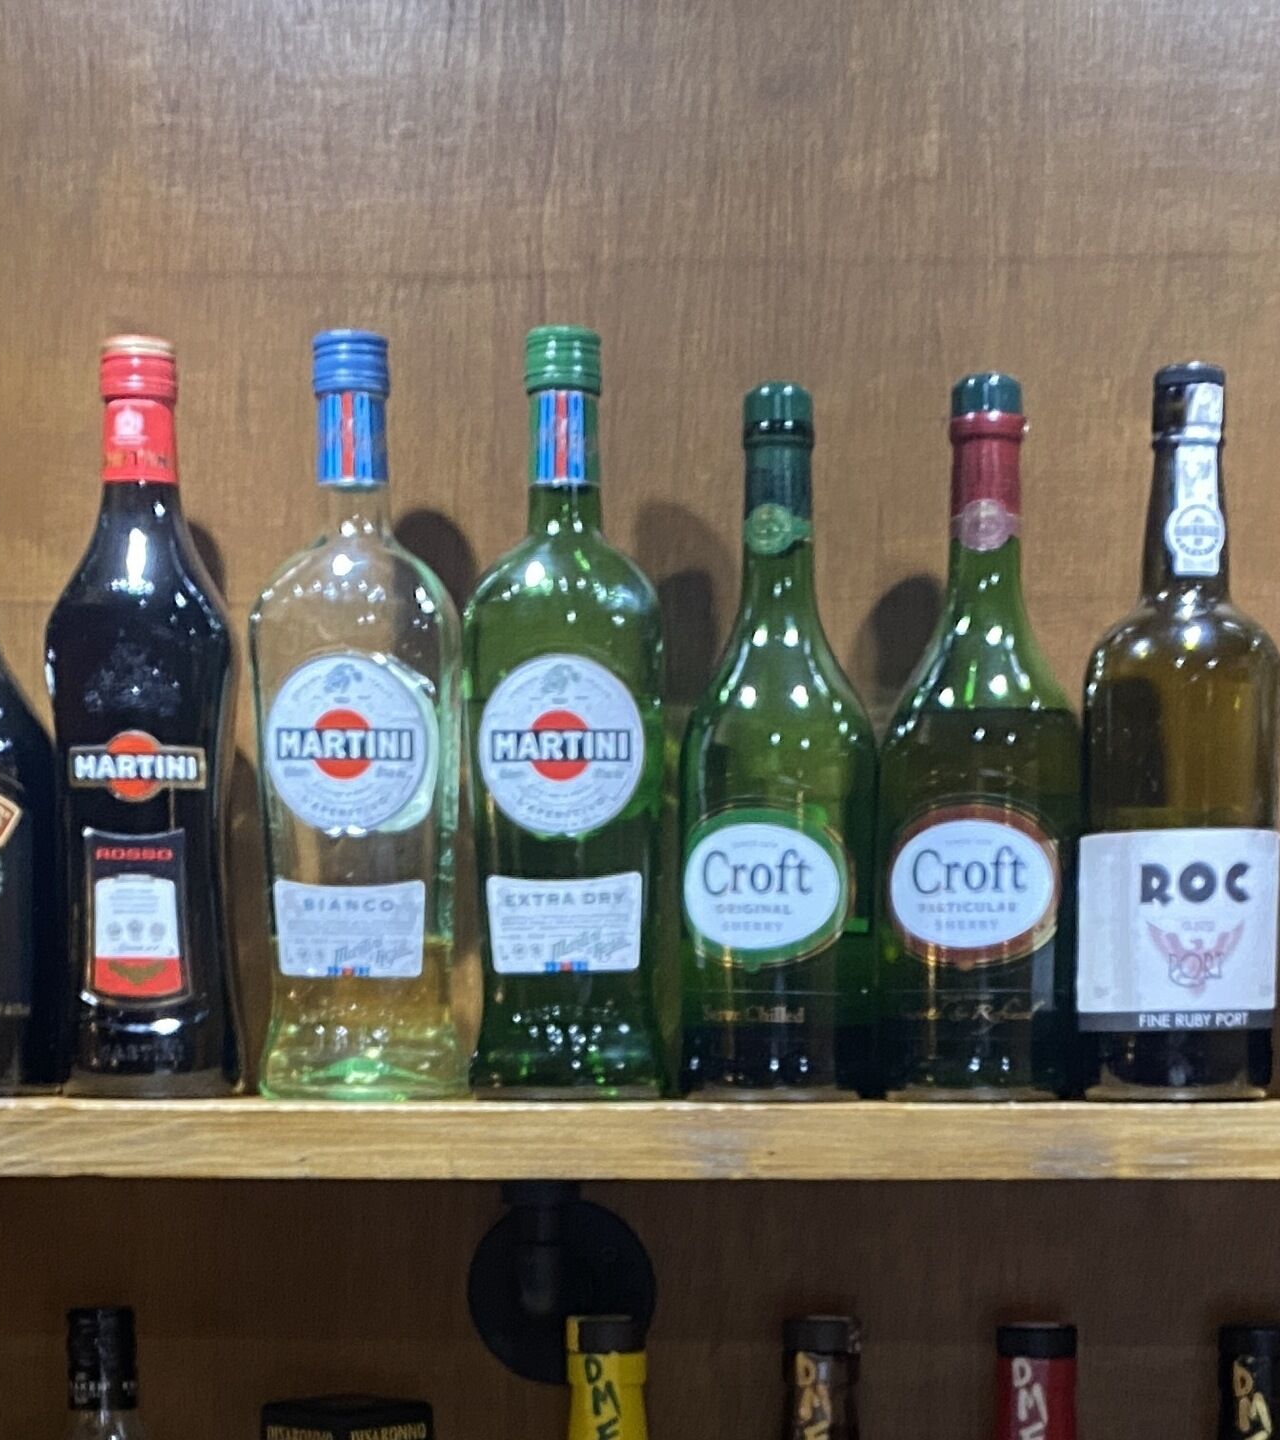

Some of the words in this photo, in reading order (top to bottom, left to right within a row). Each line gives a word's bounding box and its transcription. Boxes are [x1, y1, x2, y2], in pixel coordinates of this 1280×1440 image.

[278, 729, 414, 760] MARTINI
[493, 730, 629, 761] MARTINI
[74, 754, 198, 780] MARTINI
[702, 848, 813, 896] Croft
[912, 845, 1028, 896] Croft
[1139, 861, 1252, 907] ROC
[303, 897, 396, 913] BIANCO
[504, 892, 576, 909] EXTRA
[580, 892, 626, 906] DRY
[1138, 1013, 1171, 1029] FINE
[1174, 1012, 1212, 1028] RUBY
[1214, 1011, 1250, 1027] PORT
